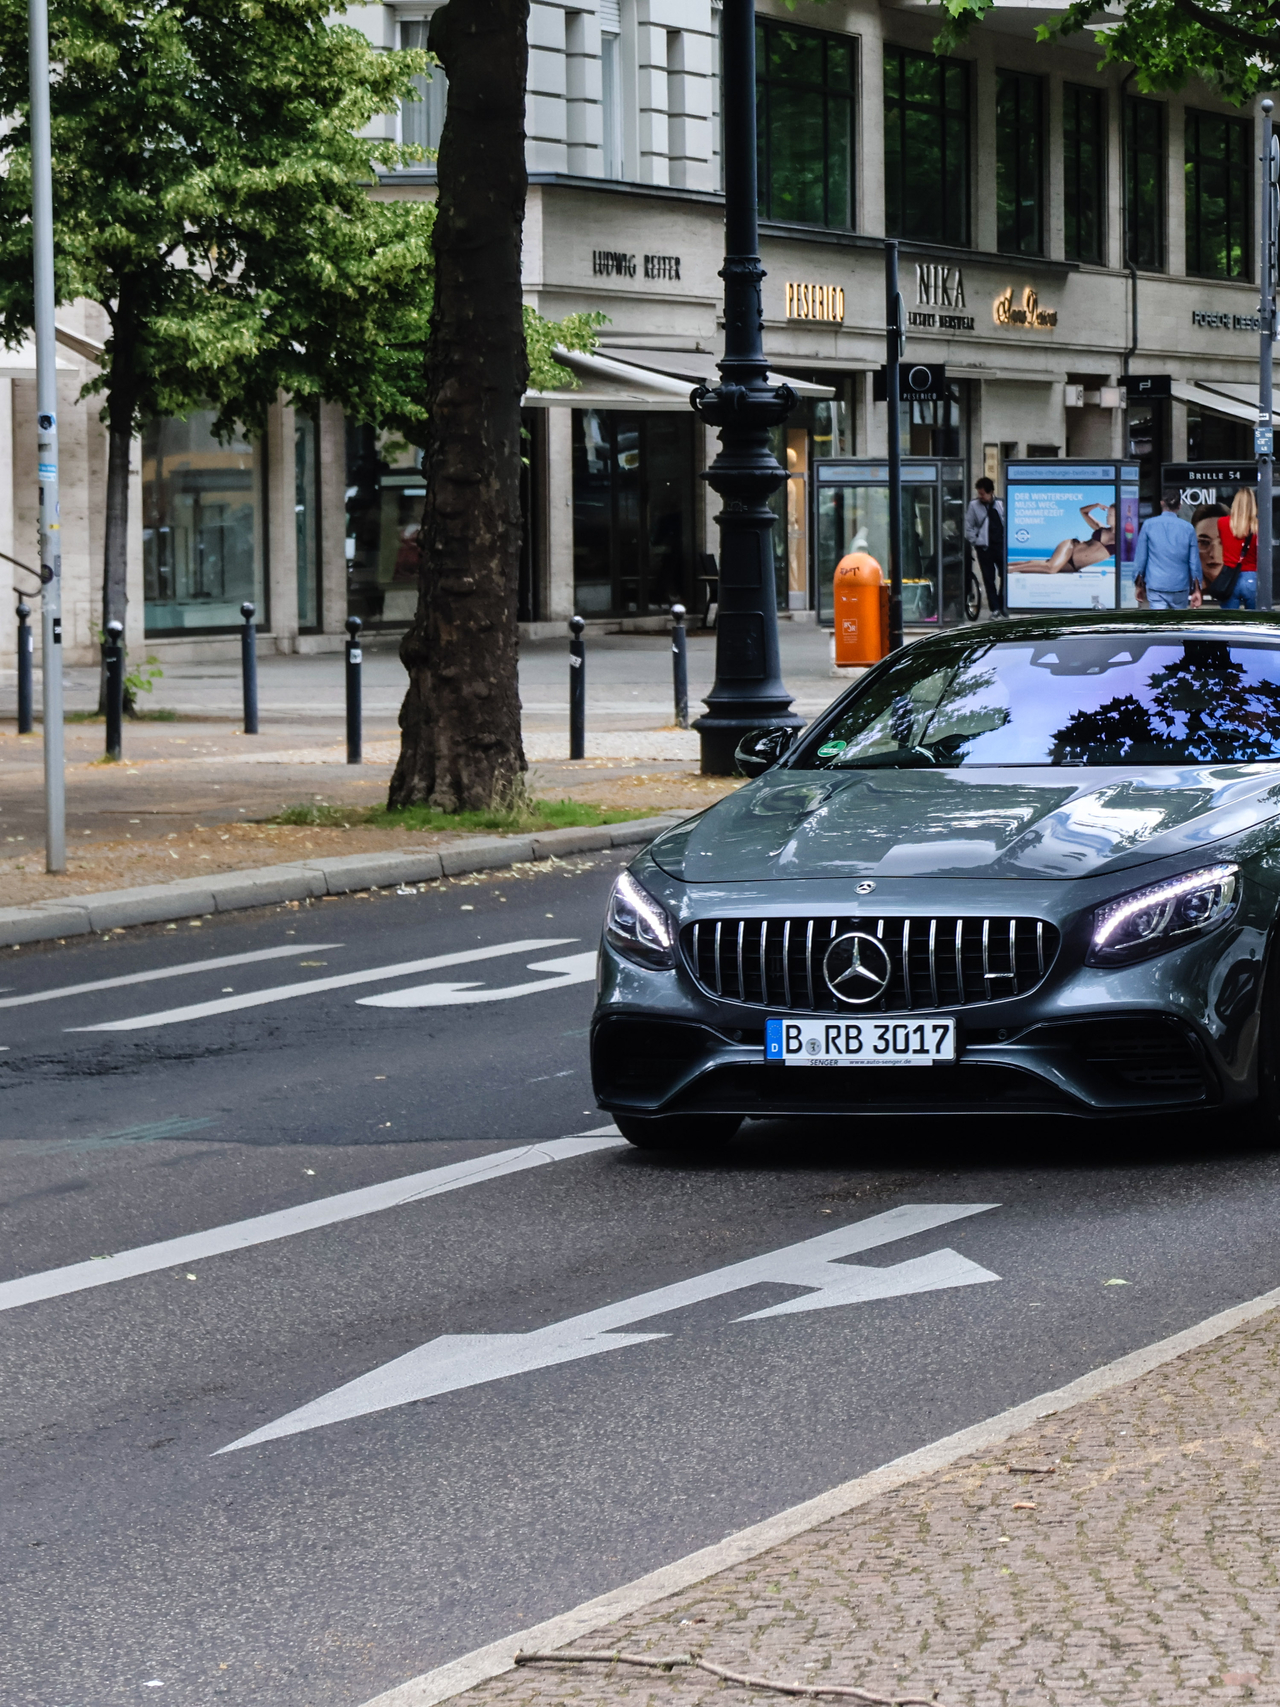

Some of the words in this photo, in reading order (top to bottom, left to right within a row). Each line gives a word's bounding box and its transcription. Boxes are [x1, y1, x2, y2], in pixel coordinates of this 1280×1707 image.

[593, 250, 636, 278] LUDWIG
[644, 254, 681, 281] REITER
[916, 264, 966, 308] NIKA
[785, 282, 844, 322] PESERICO
[1192, 311, 1232, 329] PORSCHE
[1233, 314, 1260, 331] DESIG
[903, 392, 937, 400] PESERICO
[1189, 471, 1223, 480] BRILLE
[1228, 471, 1241, 480] 54
[1014, 493, 1029, 501] DER
[1031, 493, 1083, 501] WINTERSPECK
[1039, 501, 1058, 509] WEG,
[1014, 509, 1064, 517] SOMMERZEIT
[1014, 517, 1046, 525] KOMMT.
[771, 1043, 779, 1052] D
[785, 1024, 803, 1054] B
[824, 1024, 863, 1055] RB
[872, 1024, 950, 1055] 3017
[849, 1058, 912, 1066] www.auto-senger.de
